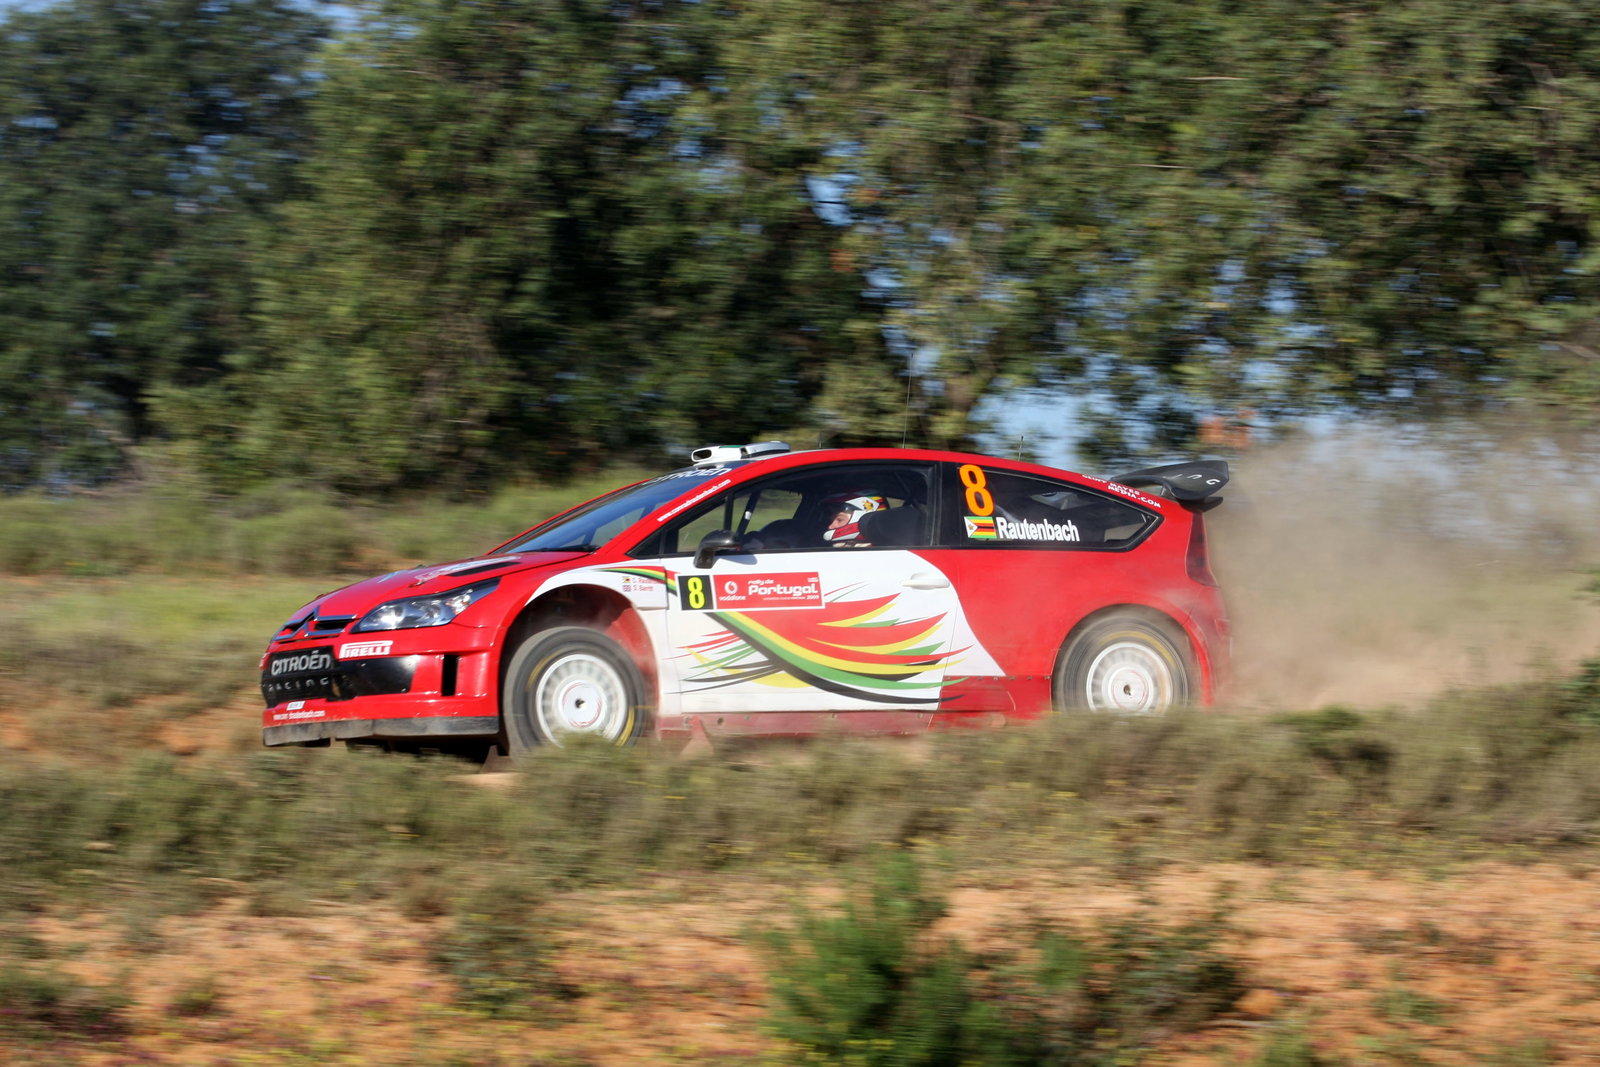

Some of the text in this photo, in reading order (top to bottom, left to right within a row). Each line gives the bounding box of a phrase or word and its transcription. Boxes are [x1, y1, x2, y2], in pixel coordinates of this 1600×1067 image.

[959, 464, 994, 516] 8
[1108, 485, 1162, 508] MEDIA.COM
[1110, 482, 1140, 495] MAYES
[996, 517, 1080, 541] Rautenbach
[687, 577, 705, 609] 8
[748, 583, 818, 597] Portugal
[339, 640, 393, 659] PIRELLI
[271, 650, 331, 676] CITROËN
